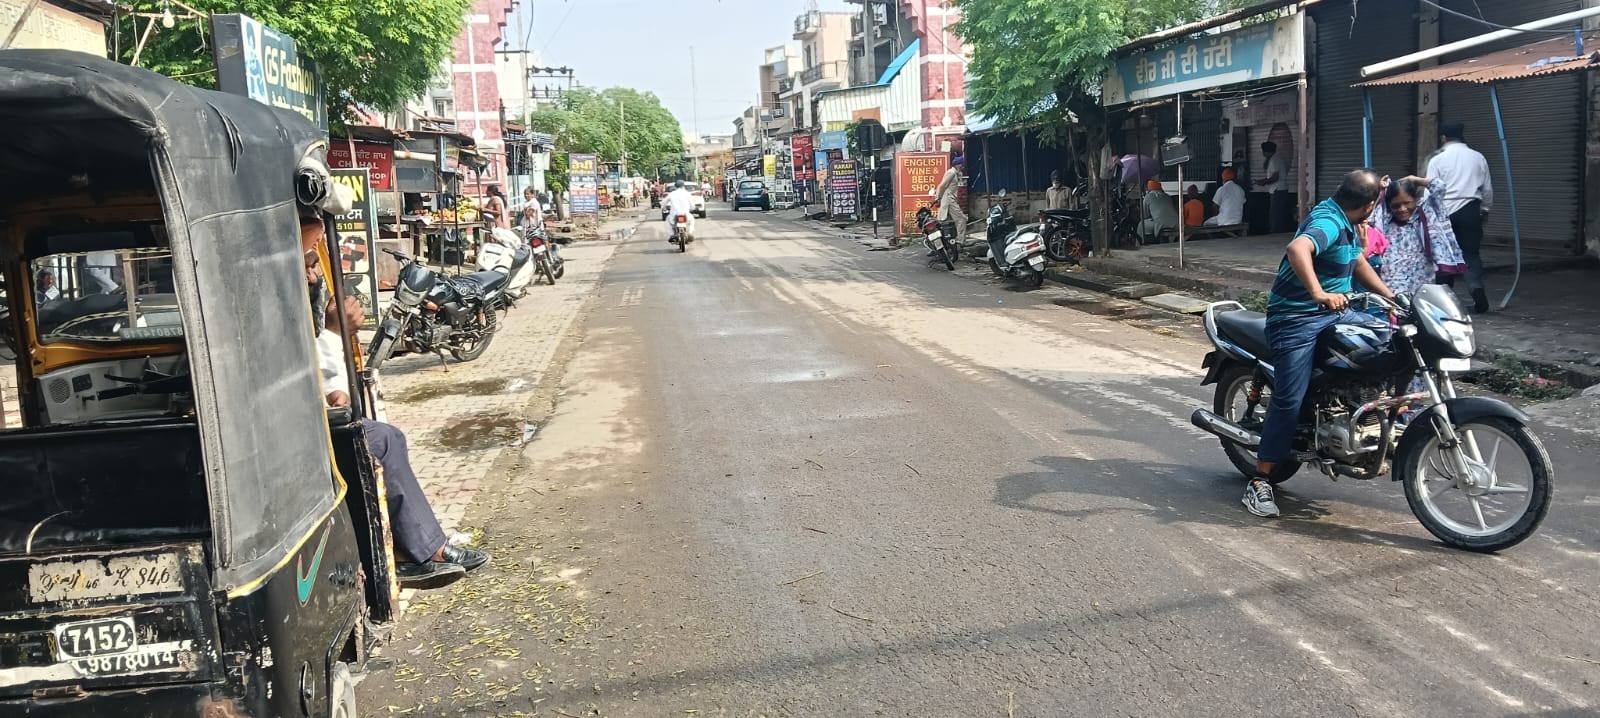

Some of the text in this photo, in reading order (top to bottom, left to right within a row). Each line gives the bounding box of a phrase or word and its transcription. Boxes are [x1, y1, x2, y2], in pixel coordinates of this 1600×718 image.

[1136, 36, 1233, 85] ਵੀਰ ਜੀ ਦੀ ਹੱਟੀ
[265, 45, 315, 97] GS Fashion
[338, 160, 379, 170] CHHAL
[904, 158, 942, 167] ENGLISH
[907, 167, 931, 175] WINE
[911, 175, 935, 183] BEER
[68, 623, 129, 655] 7152
